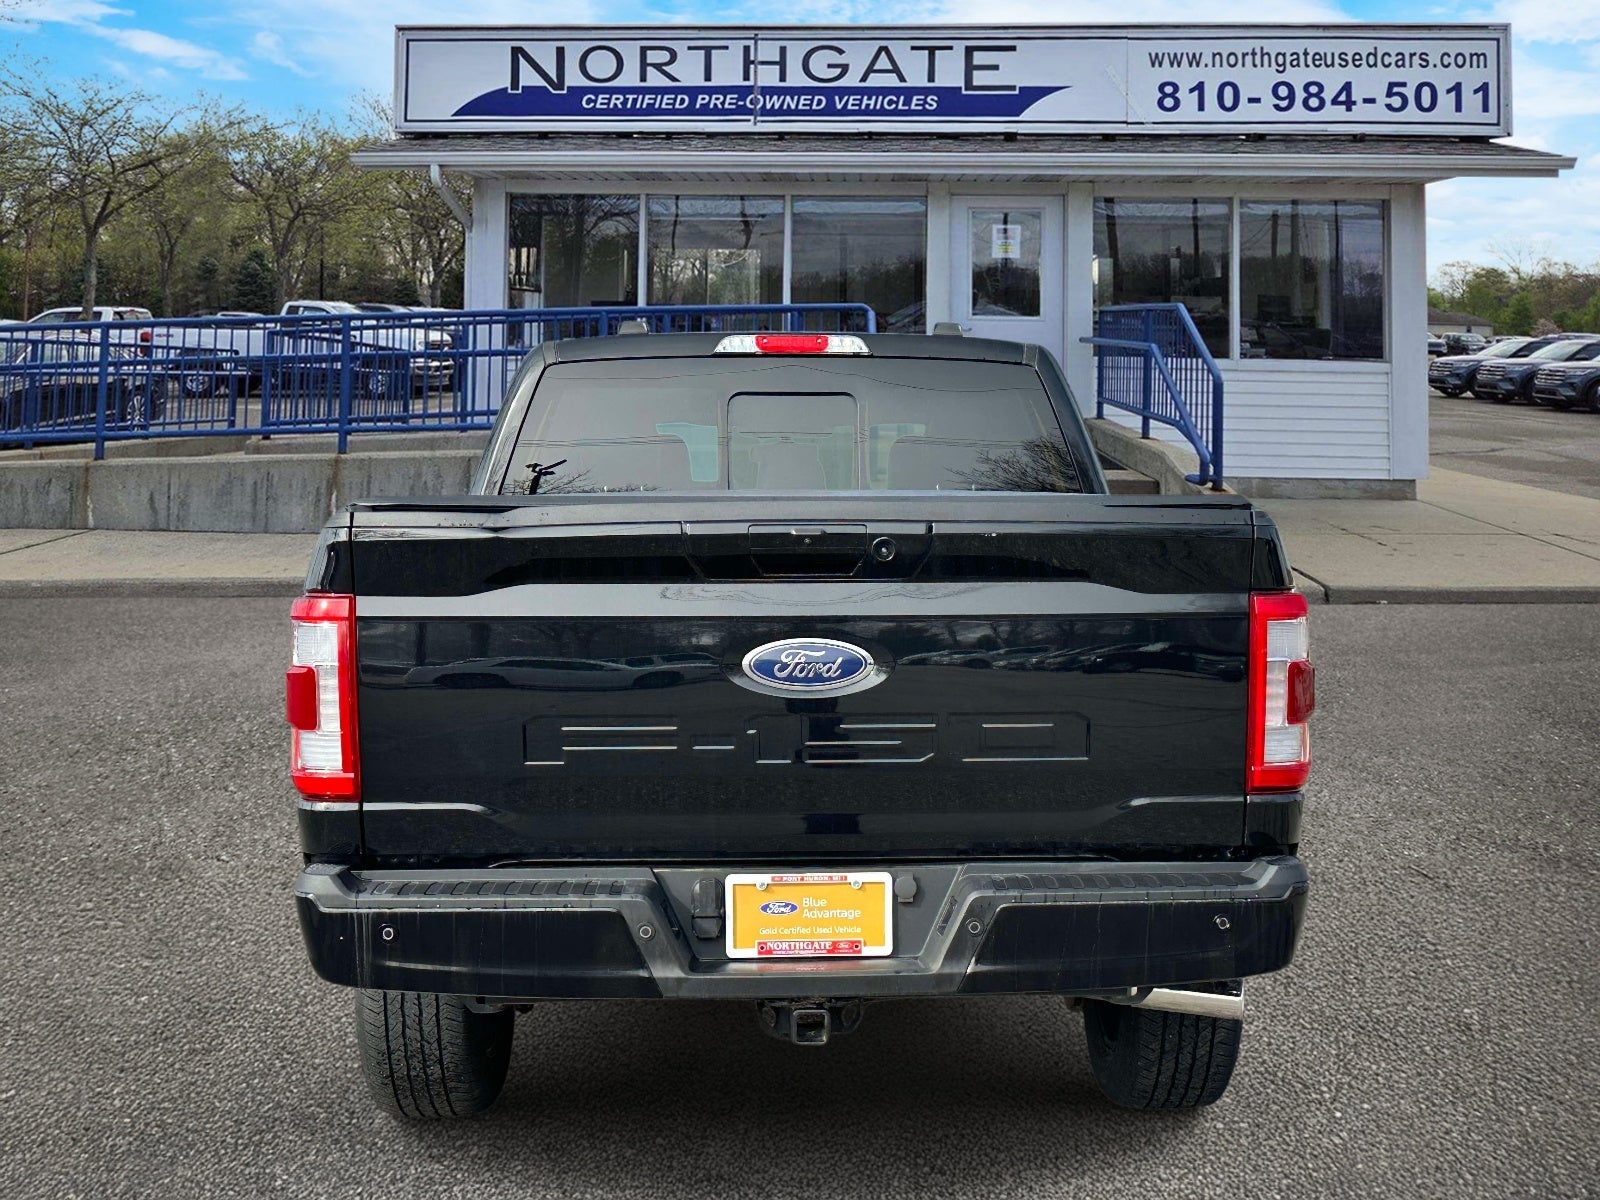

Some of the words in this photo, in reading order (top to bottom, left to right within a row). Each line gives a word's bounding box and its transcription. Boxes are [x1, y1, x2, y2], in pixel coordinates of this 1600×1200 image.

[1148, 46, 1489, 73] www.northgateusedcars.com
[509, 45, 1017, 92] NORTHGATE
[581, 93, 690, 109] CERTIFIED
[695, 93, 827, 111] PRE-OWNED
[833, 94, 939, 111] VEHICLES
[1157, 80, 1492, 113] 810-984-5011
[774, 649, 842, 678] Ford
[766, 902, 793, 914] Ford
[802, 898, 827, 907] Blue
[802, 908, 861, 919] Advantage
[759, 927, 777, 935] Gold
[779, 926, 811, 935] Certified
[813, 926, 832, 934] Used
[835, 926, 861, 934] Vehicle
[766, 941, 832, 951] NORTHGATE
